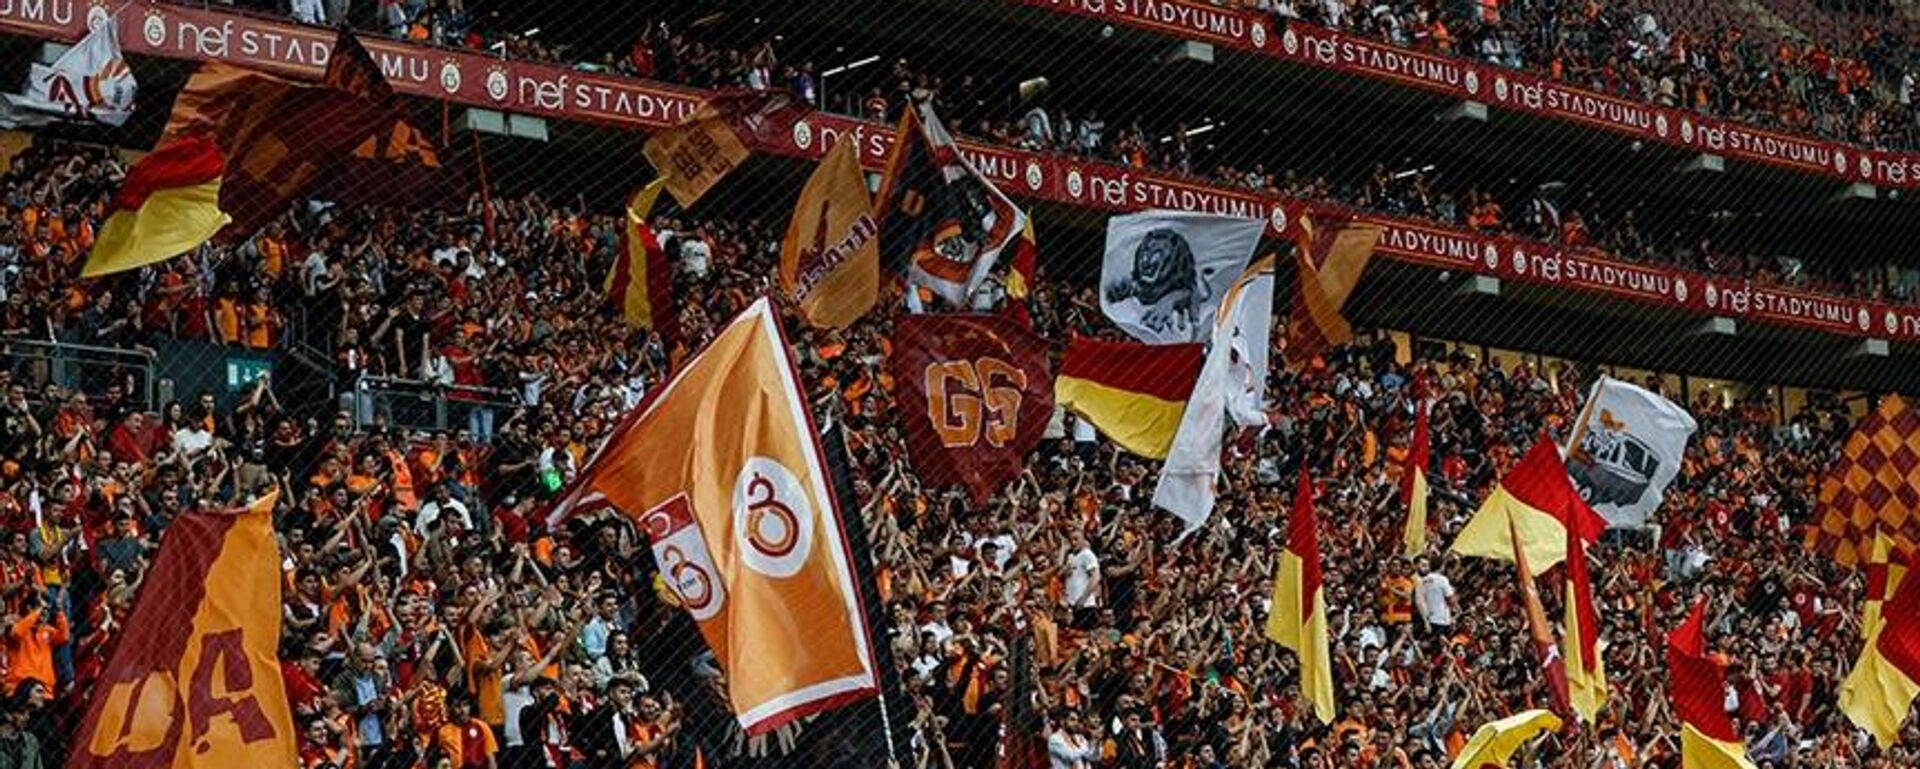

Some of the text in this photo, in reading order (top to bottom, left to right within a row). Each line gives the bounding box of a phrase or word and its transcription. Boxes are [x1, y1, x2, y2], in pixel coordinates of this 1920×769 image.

[178, 20, 233, 57] nef
[1303, 35, 1459, 84] nef STADYUMU
[518, 75, 694, 123] nef STADYU
[1512, 81, 1651, 128] nef STADYUMU
[1697, 123, 1830, 165] nef STADYUMU
[1878, 157, 1908, 183] nef
[1090, 173, 1264, 220] nef STADYUMU
[1380, 227, 1479, 260] TADYUMU
[1531, 252, 1670, 295] nef STADYUMU
[1754, 292, 1853, 323] STADYUMU
[925, 356, 1028, 448] GS
